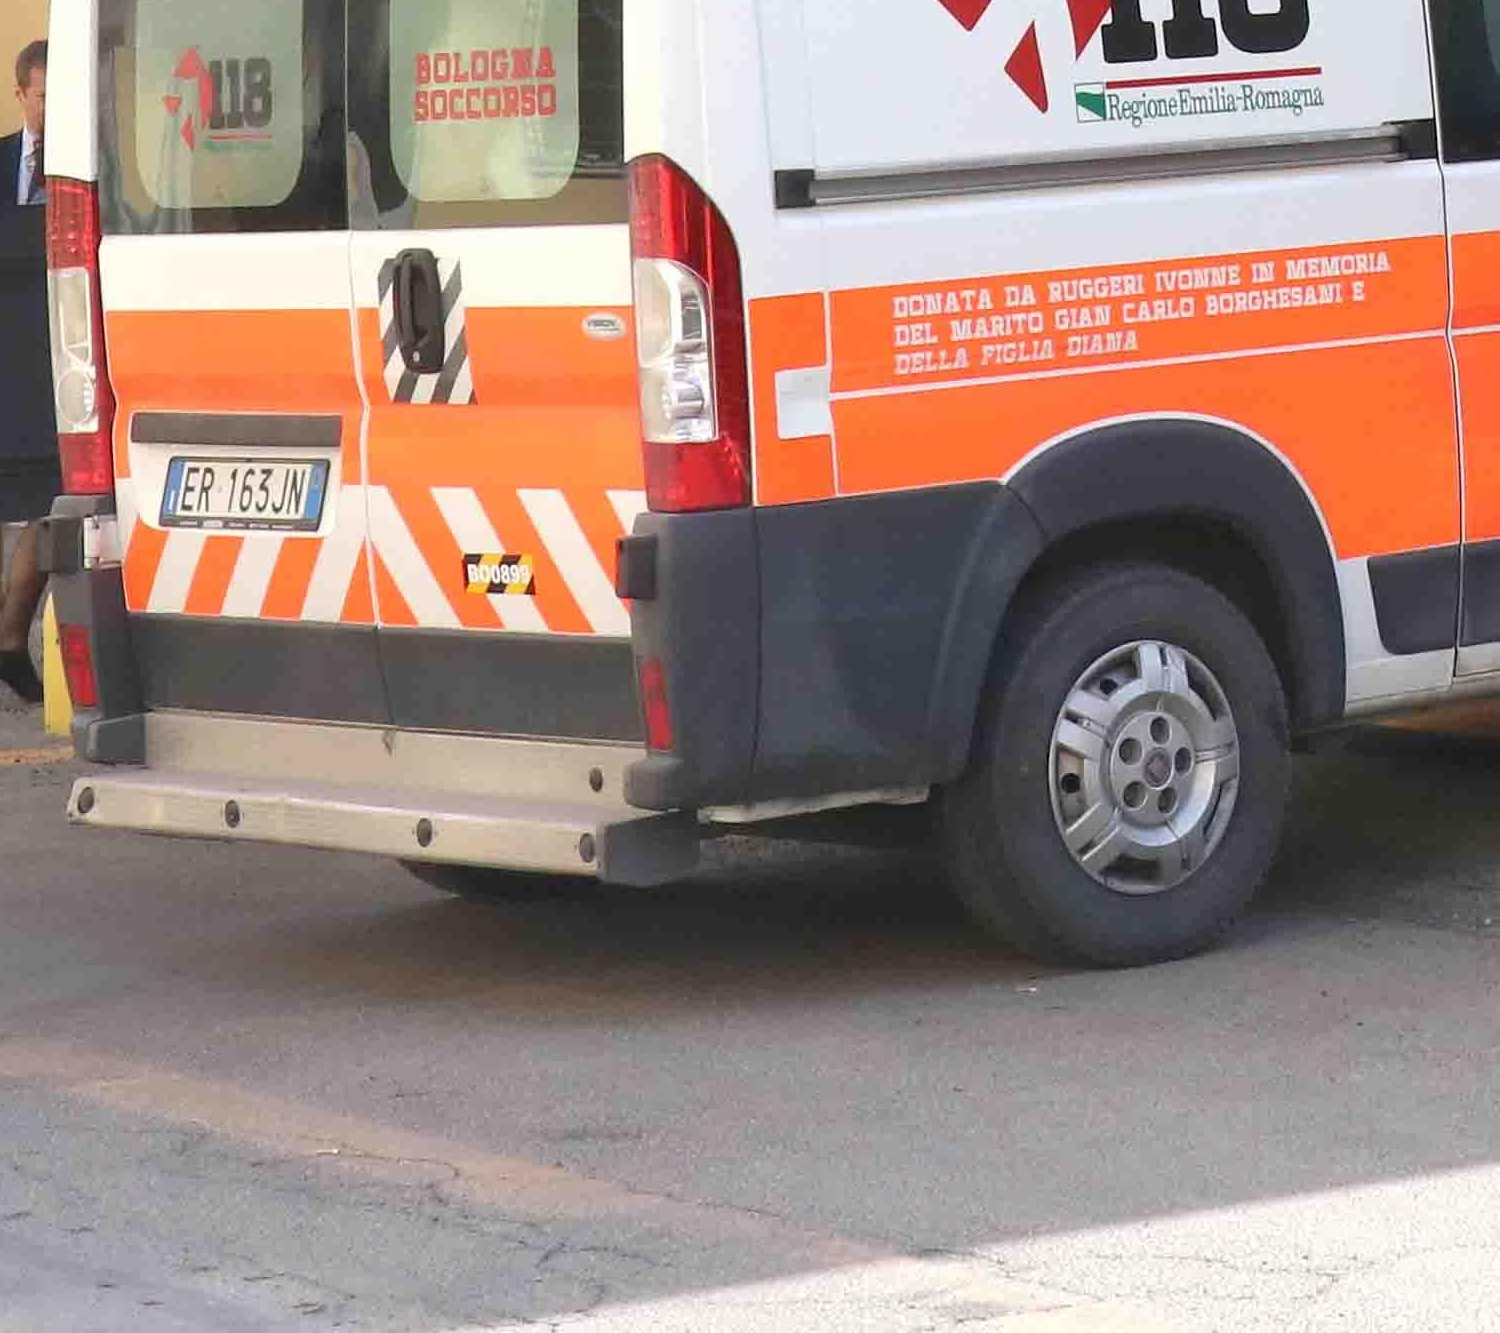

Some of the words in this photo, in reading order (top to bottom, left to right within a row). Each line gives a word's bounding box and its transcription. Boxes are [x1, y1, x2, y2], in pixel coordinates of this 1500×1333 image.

[414, 45, 557, 85] BOLOGNA
[210, 56, 273, 130] 118
[414, 83, 557, 122] SOCCORSO
[893, 288, 994, 318] DONATA
[1004, 284, 1037, 308] DA
[1048, 274, 1145, 303] RUGGERI
[1155, 264, 1241, 293] IVONNE
[1251, 261, 1275, 283] IN
[1286, 252, 1391, 281] MEMORIA
[894, 322, 938, 346] DEL
[950, 311, 1044, 341] MARITO
[1054, 304, 1111, 330] GIAN
[1122, 296, 1195, 324] CARLO
[1206, 282, 1343, 316] BORGHESANI
[1352, 281, 1365, 301] E
[894, 347, 969, 374] DELLA
[980, 338, 1055, 365] FIGLIA
[1067, 330, 1139, 356] DIANA
[180, 466, 215, 513] ER
[228, 467, 307, 515] 163JN
